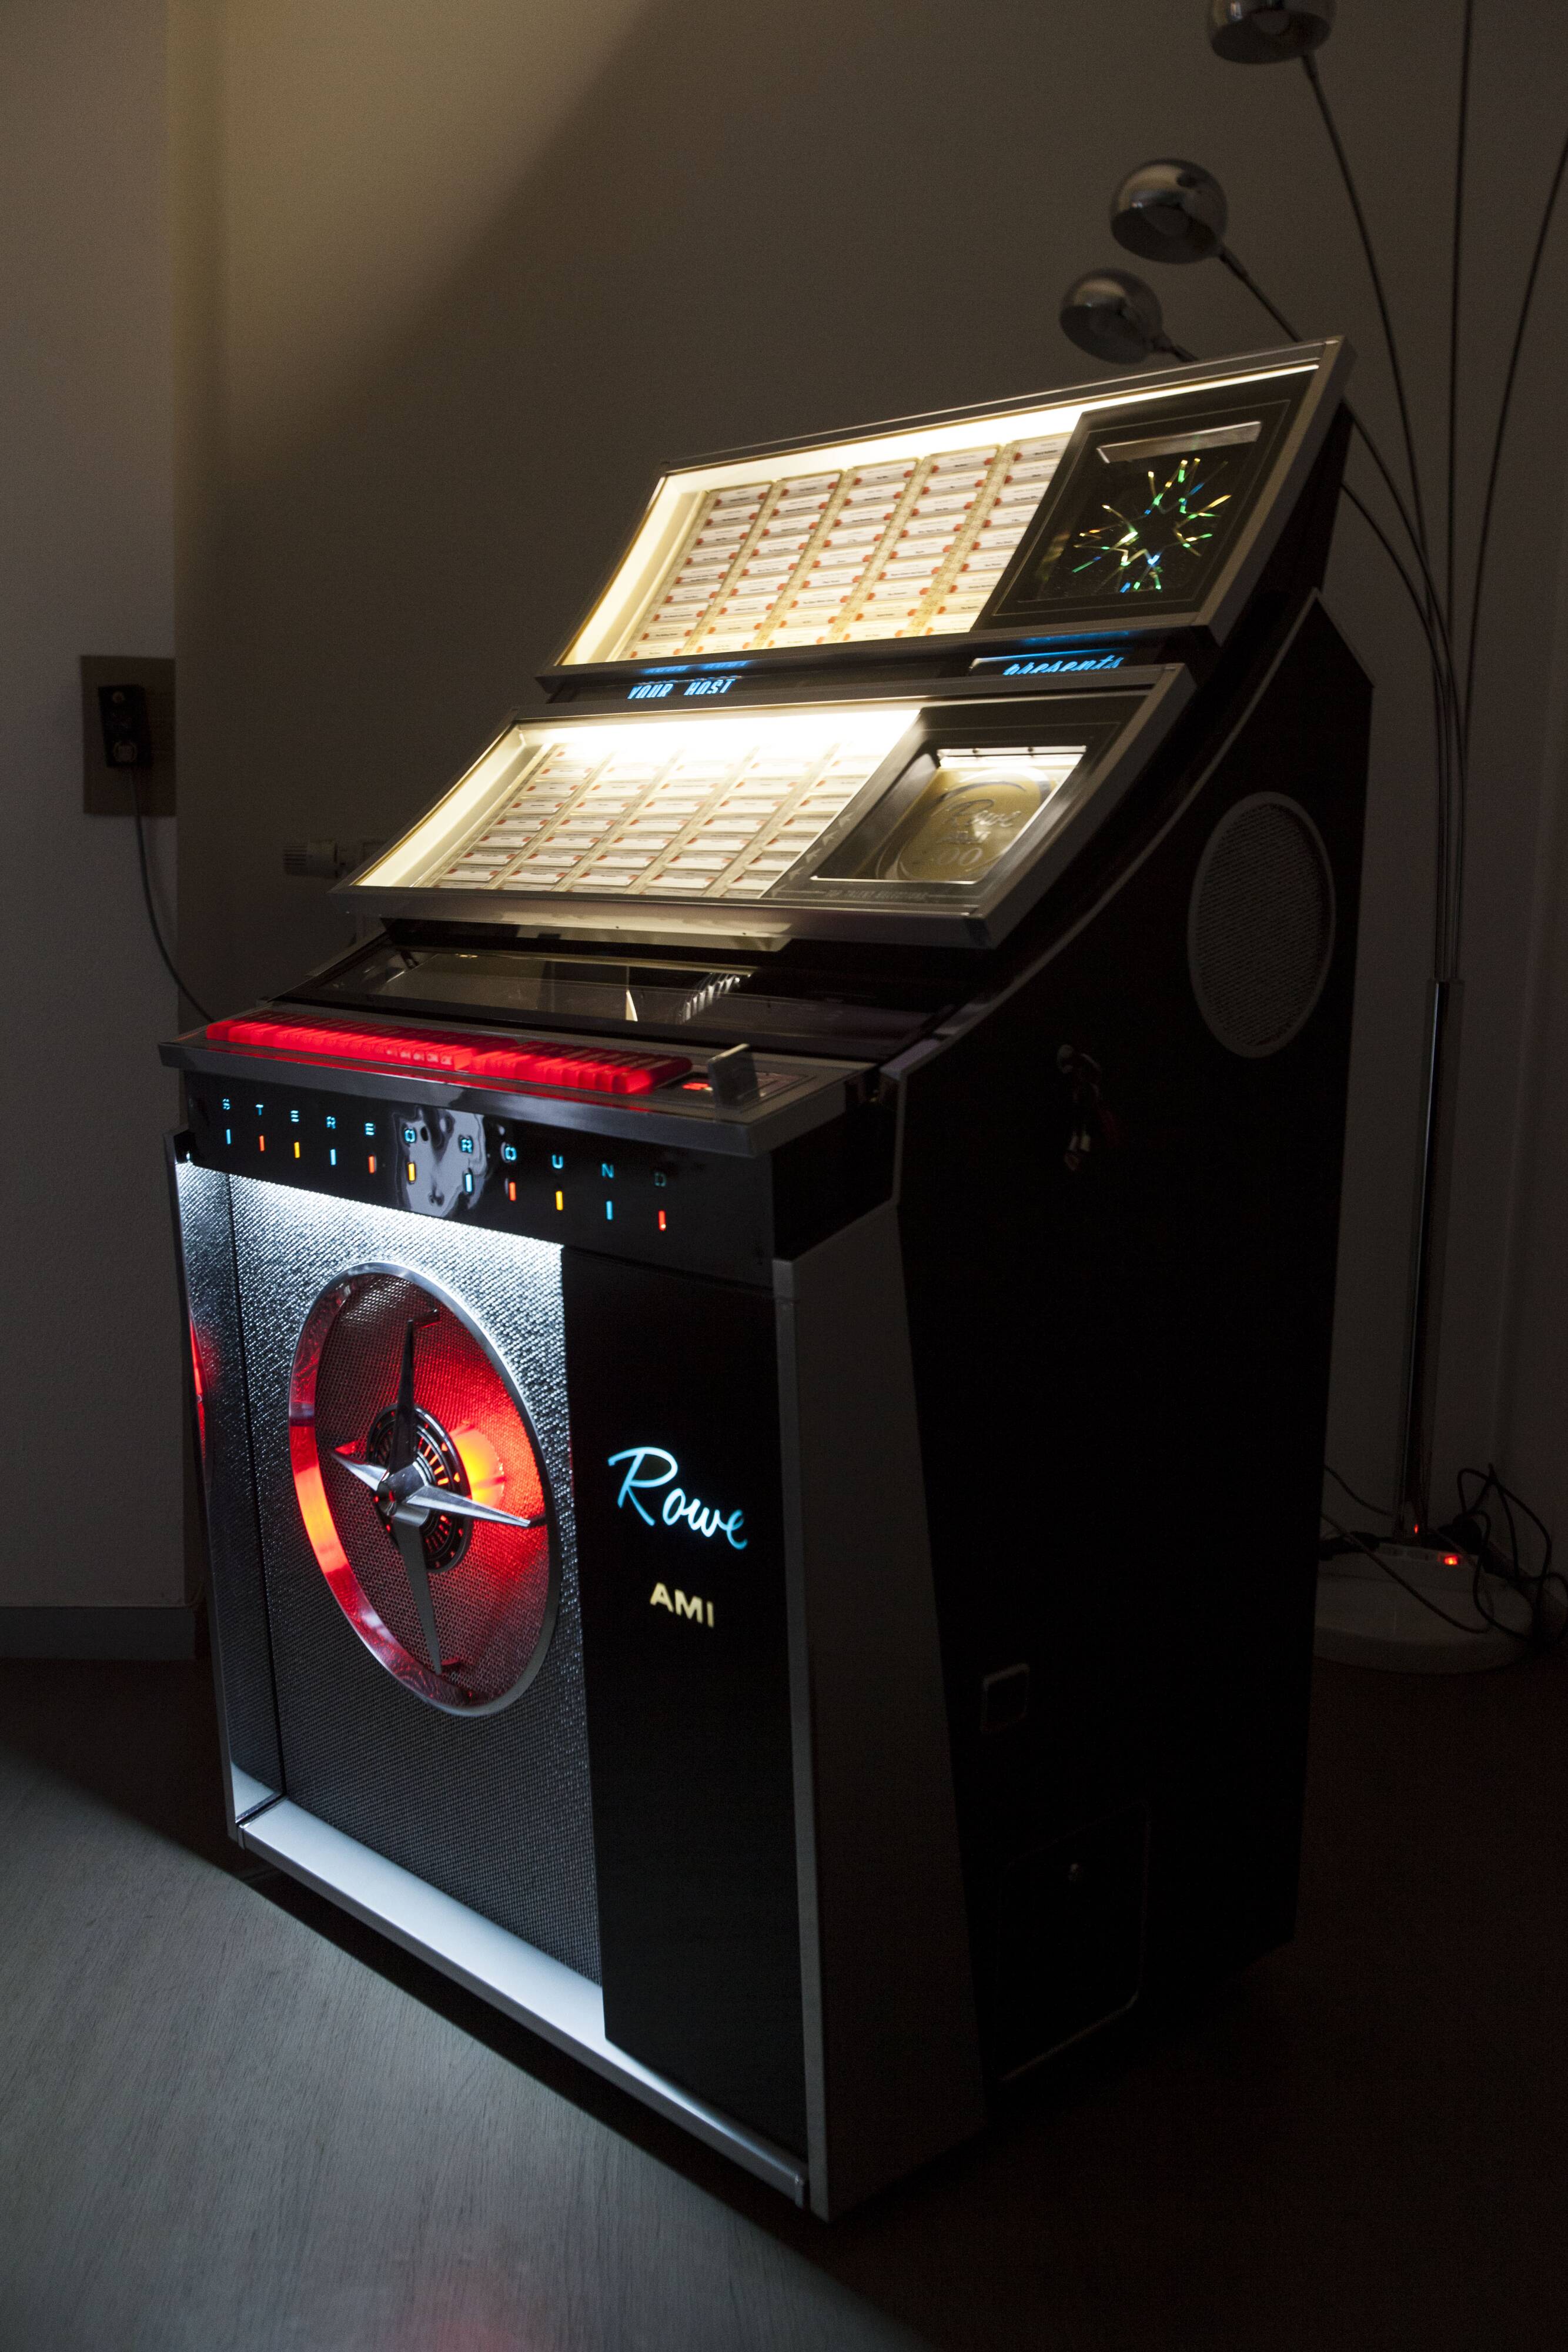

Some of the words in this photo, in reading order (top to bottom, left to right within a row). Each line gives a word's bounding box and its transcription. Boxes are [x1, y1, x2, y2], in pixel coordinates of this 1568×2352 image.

[627, 683, 674, 699] YOUR
[683, 679, 736, 695] HOST
[1003, 654, 1124, 675] presents
[222, 1098, 416, 1143] STEREO
[460, 1135, 667, 1188] ROUND
[607, 1446, 748, 1549] Rowe
[650, 1582, 714, 1628] AMI
